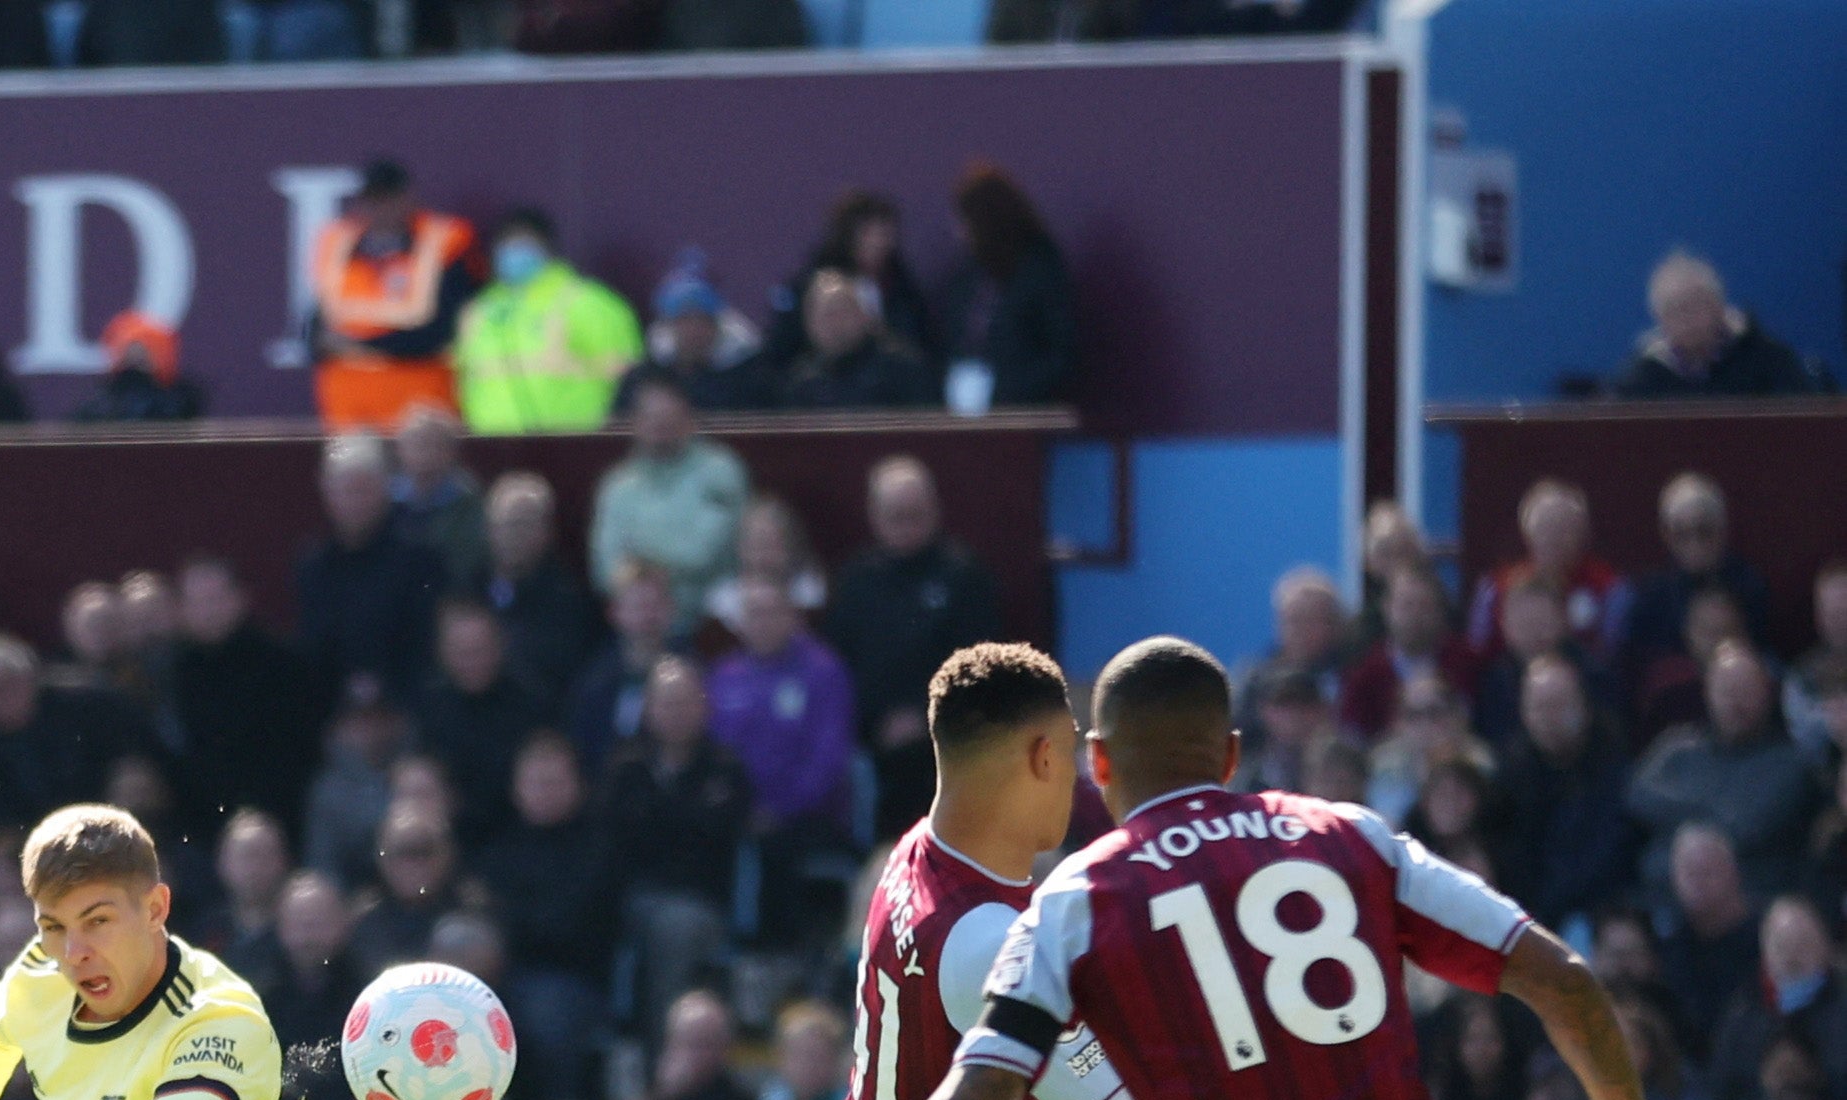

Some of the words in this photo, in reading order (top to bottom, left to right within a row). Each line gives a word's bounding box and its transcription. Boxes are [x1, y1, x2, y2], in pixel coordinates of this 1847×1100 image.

[1127, 810, 1309, 871] YOUNG
[1148, 858, 1388, 1072] 18
[191, 1036, 237, 1052] VISIT
